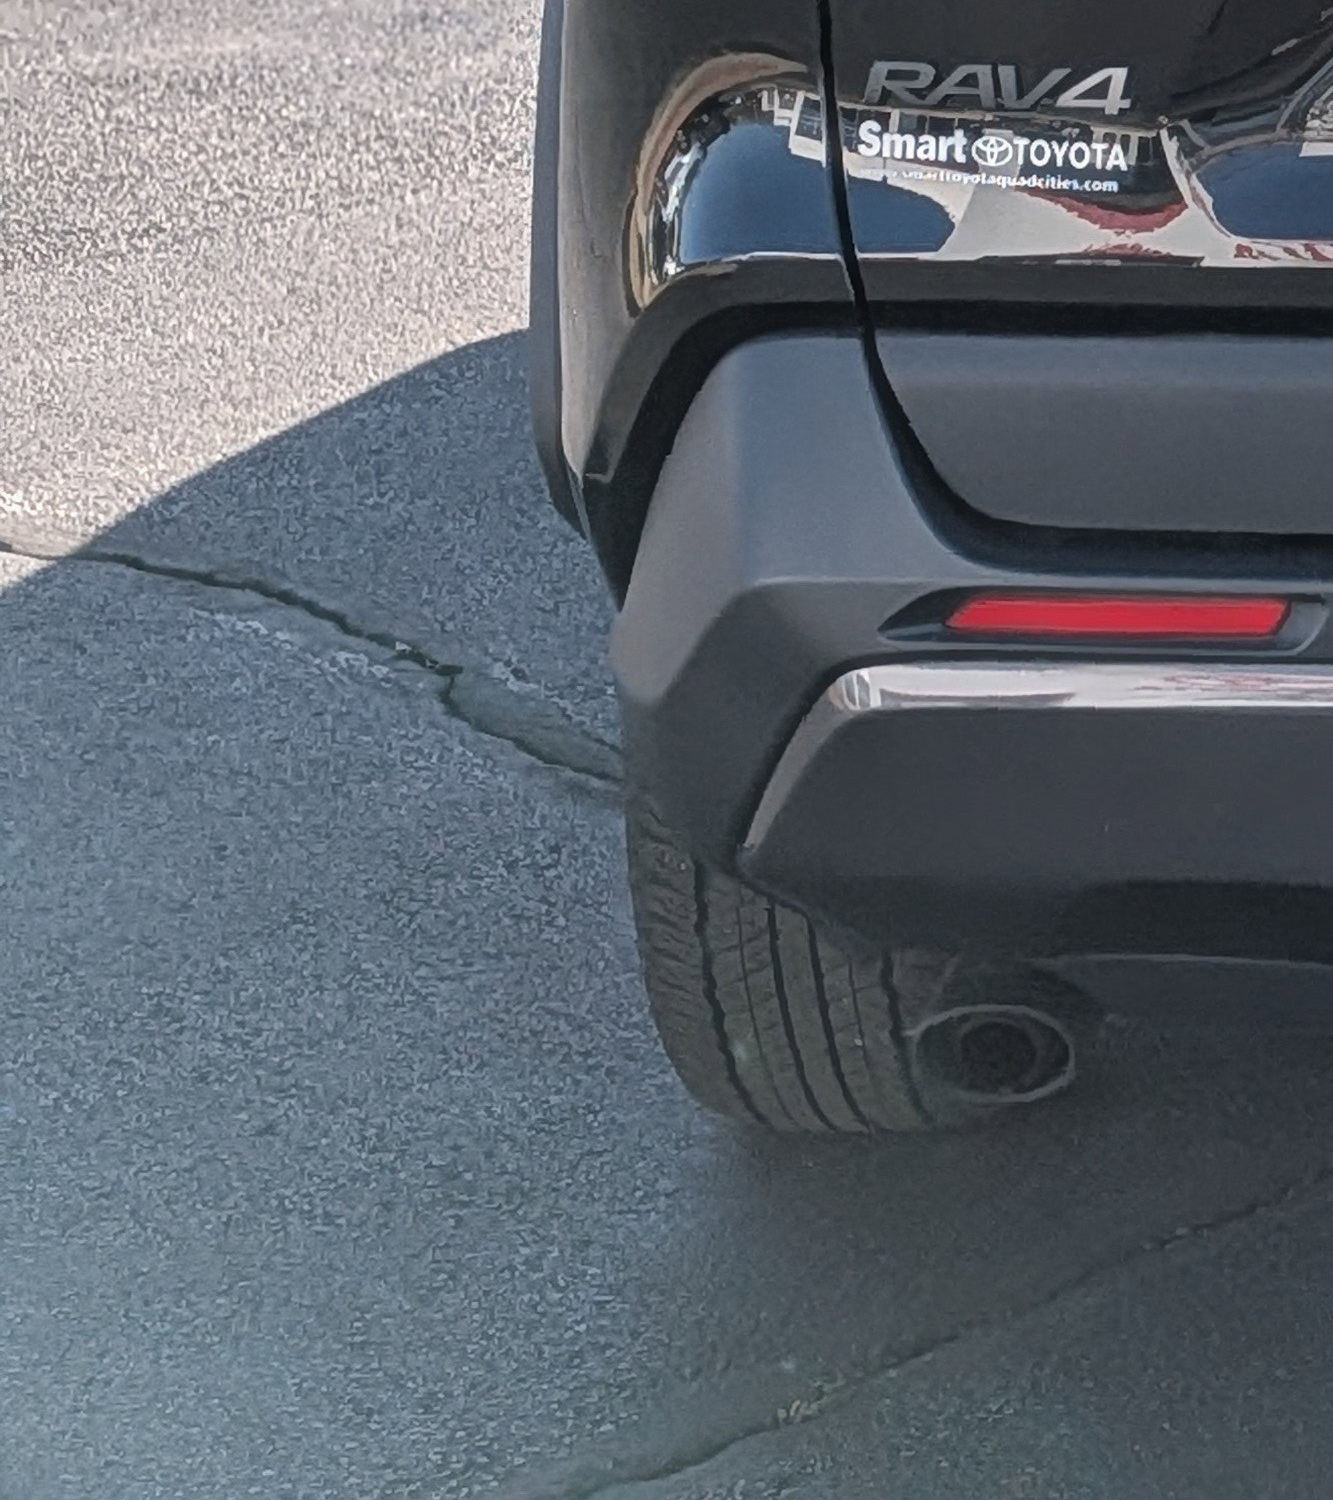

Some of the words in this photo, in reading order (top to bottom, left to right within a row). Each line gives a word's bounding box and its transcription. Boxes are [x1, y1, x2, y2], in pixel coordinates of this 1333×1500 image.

[863, 59, 1132, 116] RAV4
[857, 120, 967, 164] Smart
[1014, 137, 1129, 173] TOYOTA
